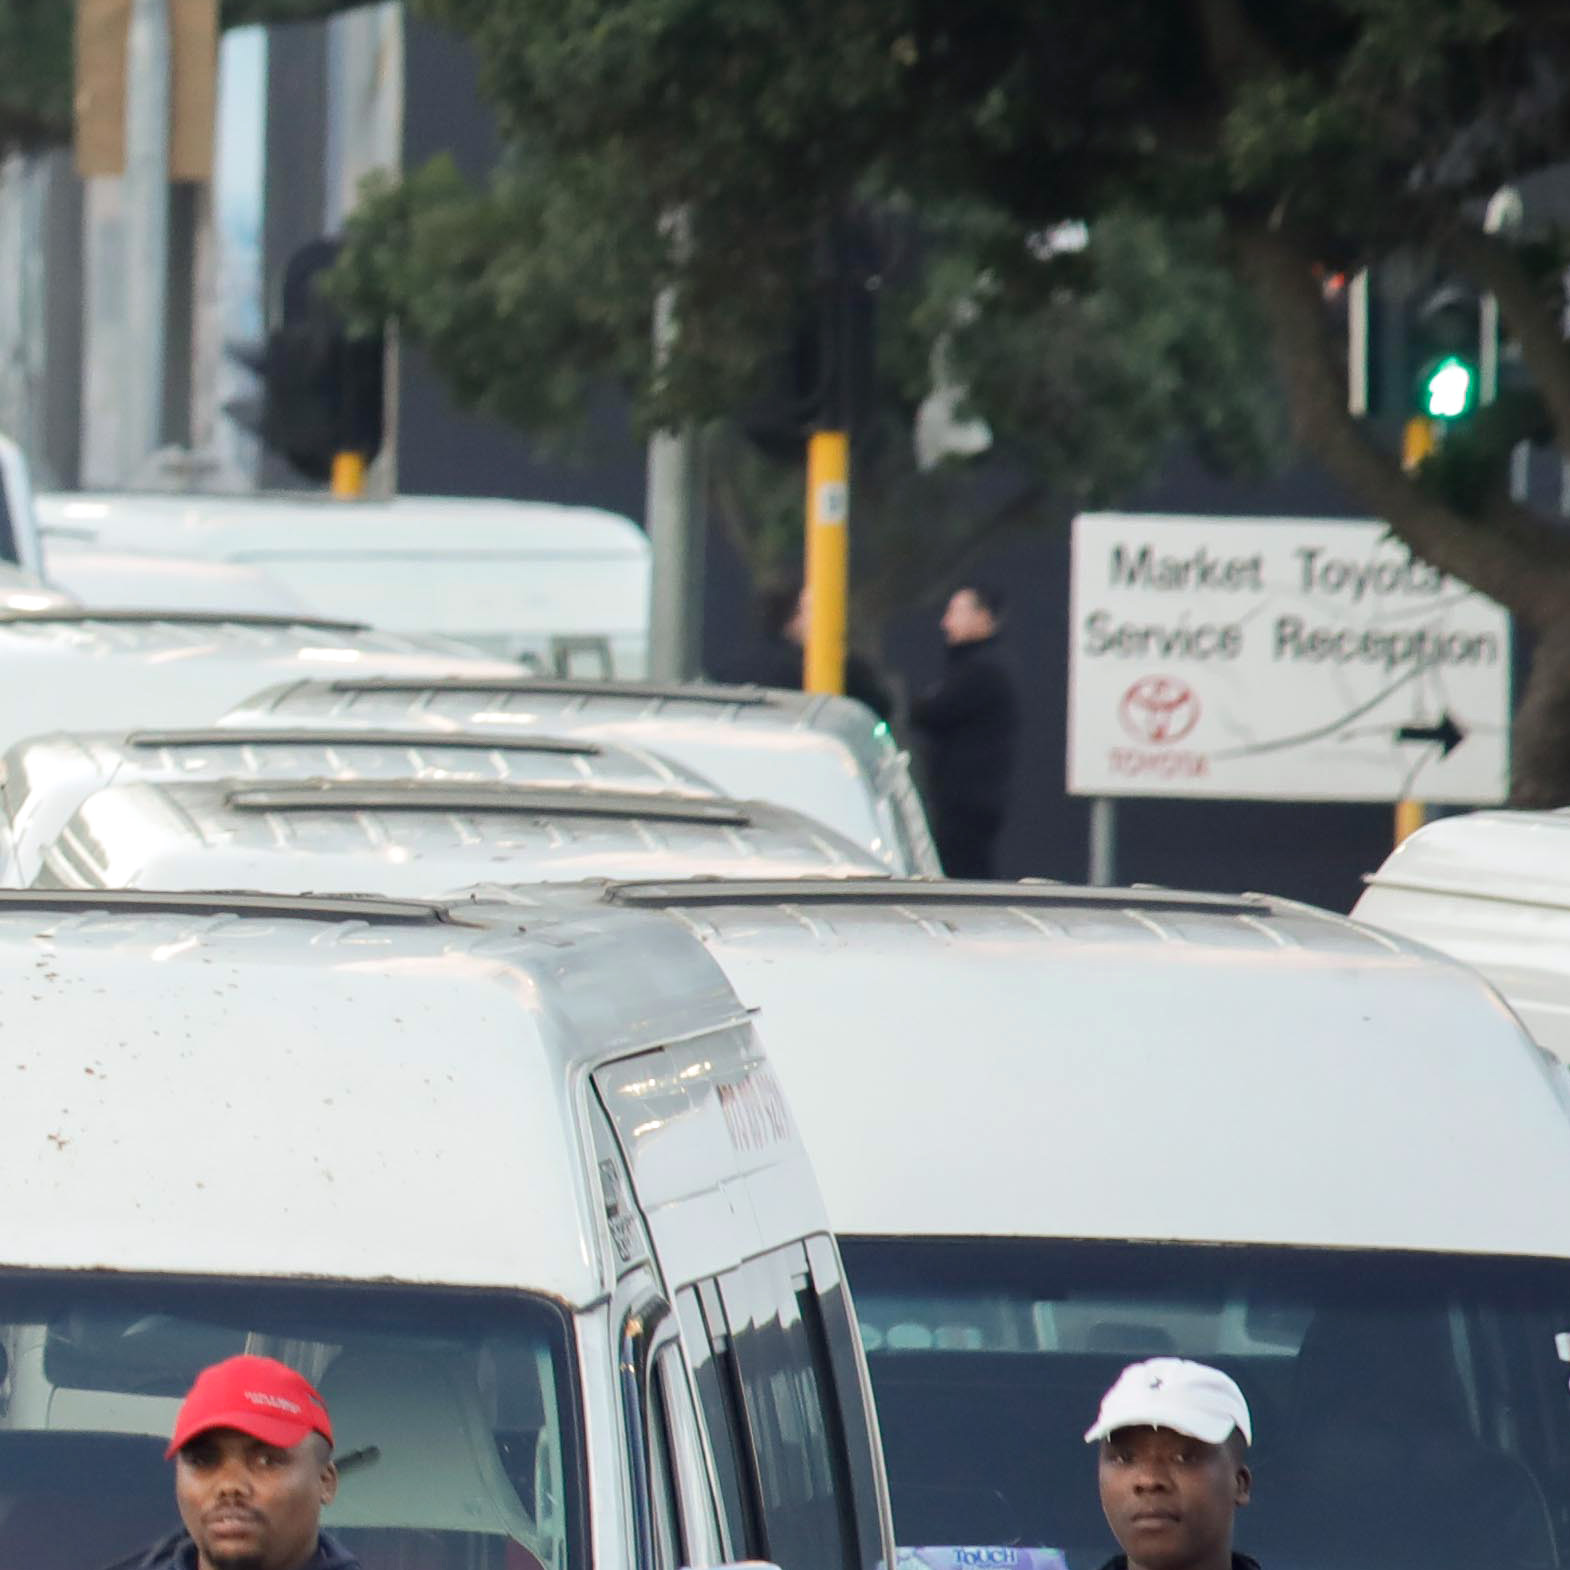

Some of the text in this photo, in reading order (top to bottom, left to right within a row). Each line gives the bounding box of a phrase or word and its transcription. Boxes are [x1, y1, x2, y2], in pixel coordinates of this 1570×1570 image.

[1108, 544, 1445, 603] Market Toyota
[1084, 610, 1500, 674] Service Reception
[1107, 748, 1210, 779] TOYOTA
[954, 1548, 1018, 1565] TOUCH
